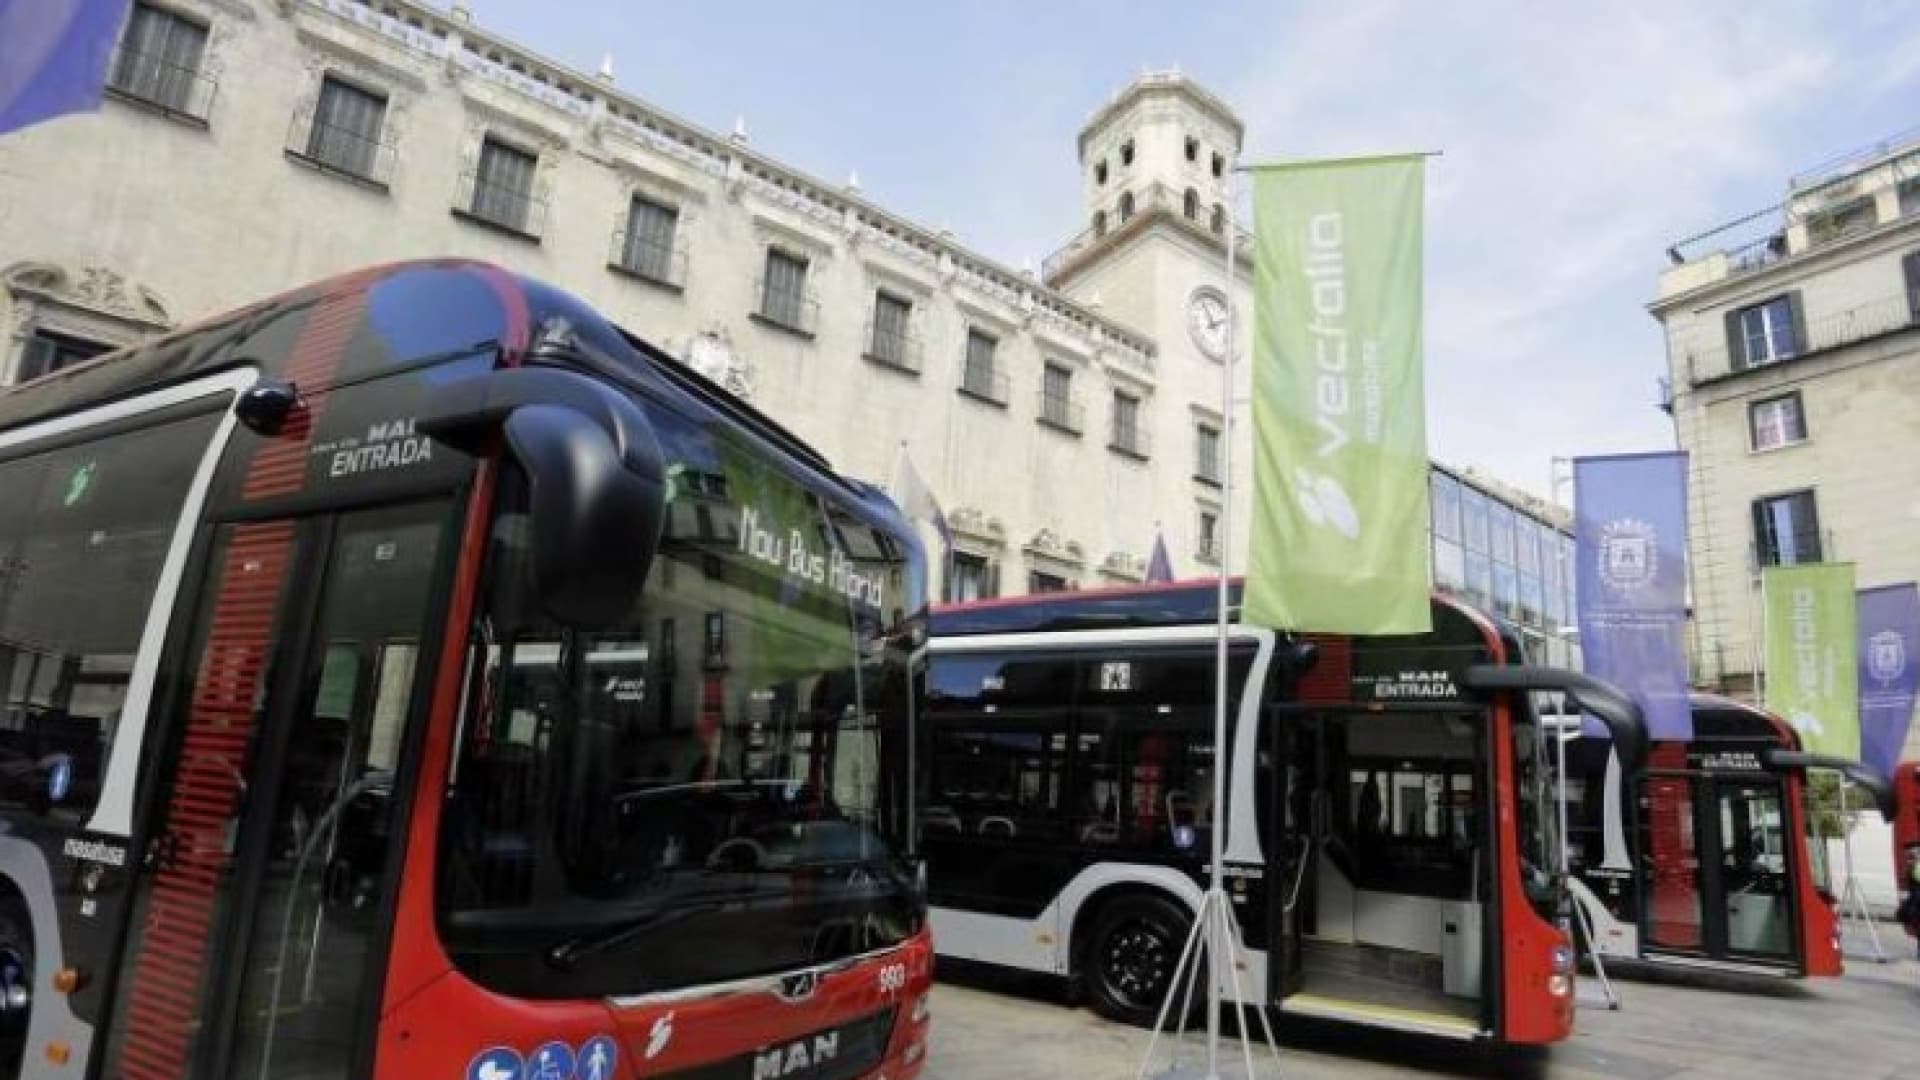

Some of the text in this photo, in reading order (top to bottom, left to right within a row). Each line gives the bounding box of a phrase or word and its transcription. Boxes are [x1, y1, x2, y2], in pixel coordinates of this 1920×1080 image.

[1304, 212, 1349, 457] vectalia
[331, 436, 431, 476] ENTRADA
[788, 529, 825, 583] Bus
[1376, 682, 1457, 697] ENTRADA
[1399, 671, 1448, 681] MAN
[754, 1031, 839, 1080] MAN
